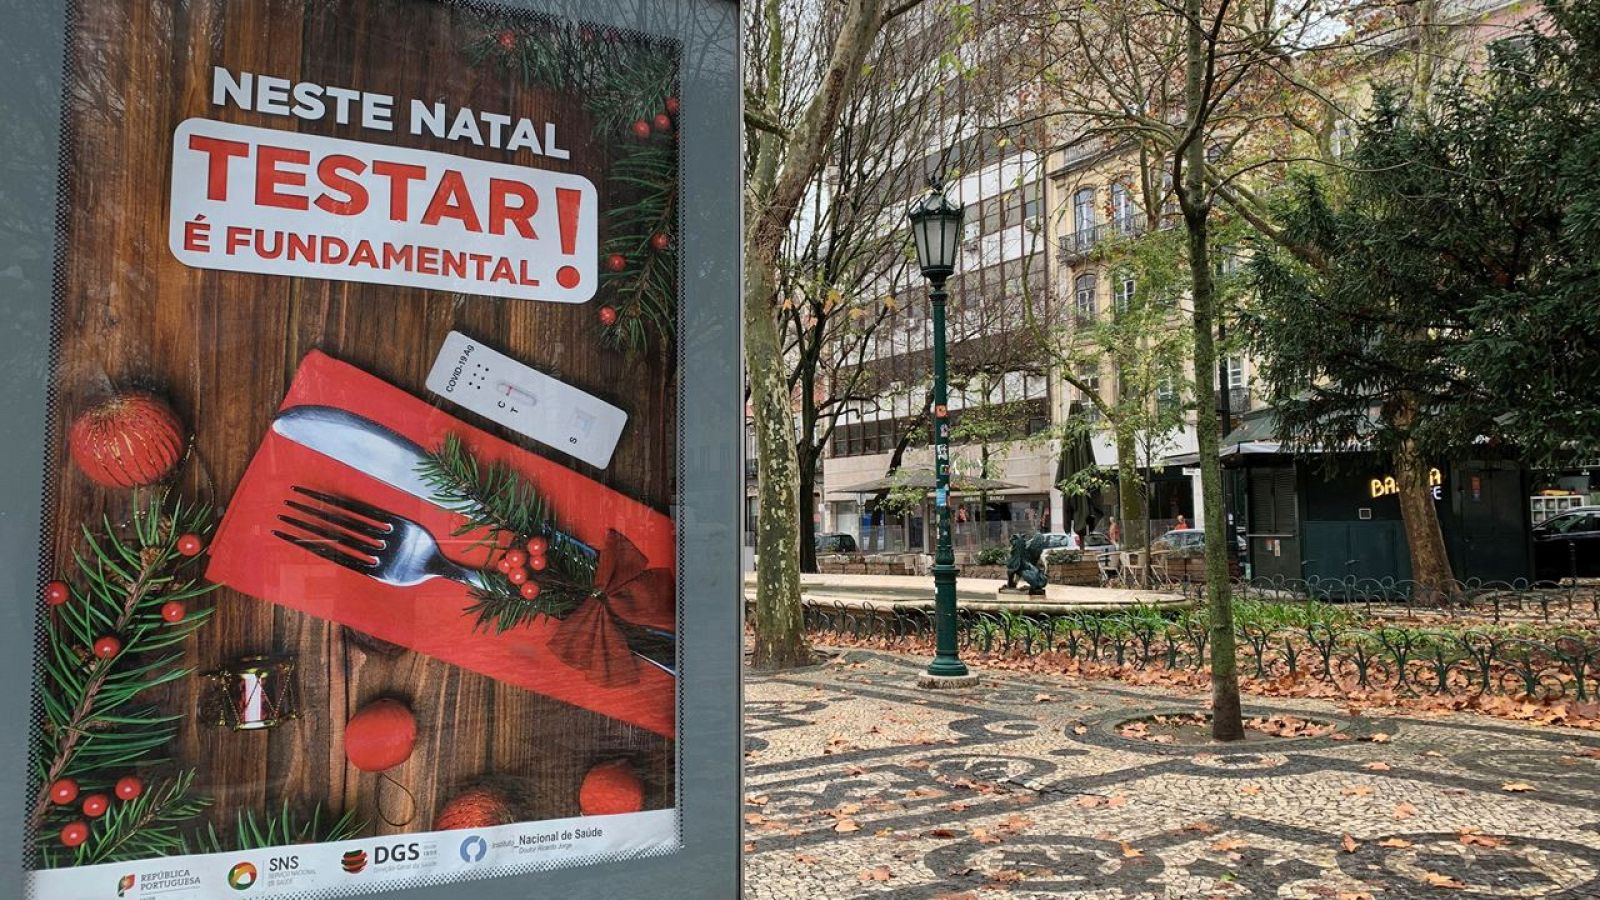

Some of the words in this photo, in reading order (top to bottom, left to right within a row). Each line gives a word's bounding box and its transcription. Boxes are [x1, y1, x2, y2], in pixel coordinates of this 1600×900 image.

[212, 65, 394, 132] NESTE
[410, 98, 571, 161] NATAL
[184, 214, 211, 253] É
[225, 224, 541, 288] FUNDAMENTAL
[445, 355, 468, 393] COVID-19
[463, 344, 475, 357] Ag
[497, 400, 506, 409] C
[569, 436, 578, 445] S
[519, 830, 559, 846] Nacional
[561, 829, 573, 841] de
[574, 827, 603, 840] Saúde
[374, 843, 420, 865] DGS
[269, 855, 300, 872] SNS
[140, 876, 201, 891] PORTUGUESA
[141, 869, 191, 882] REPÚBLICA
